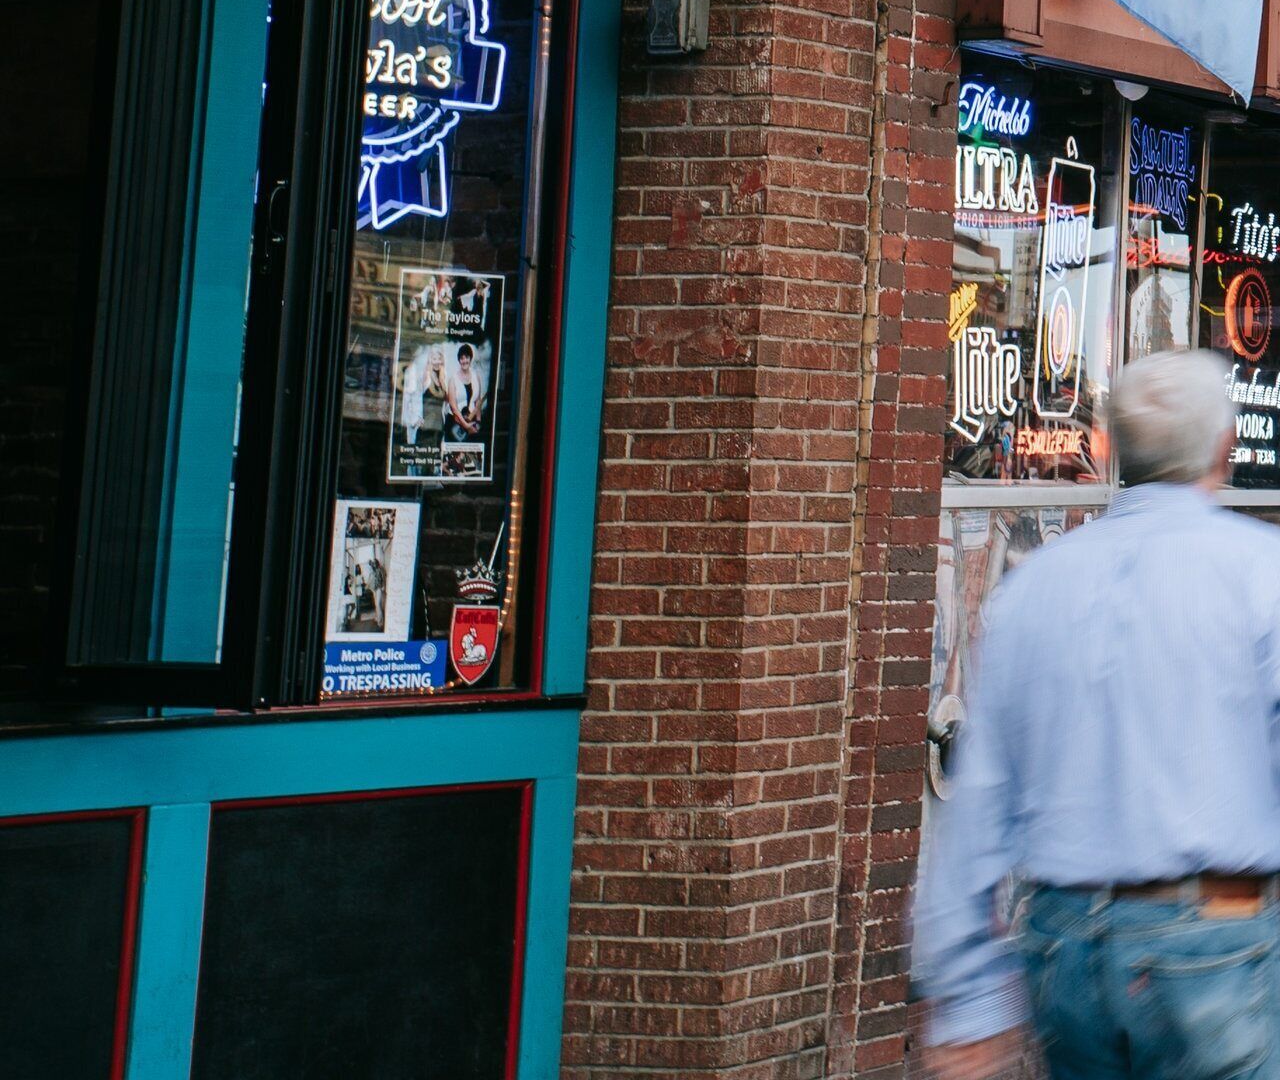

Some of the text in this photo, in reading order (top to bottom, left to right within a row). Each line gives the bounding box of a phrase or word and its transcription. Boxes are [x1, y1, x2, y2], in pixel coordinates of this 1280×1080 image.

[363, 93, 418, 119] EER
[958, 83, 1031, 135] Michelob
[1130, 117, 1195, 182] SAMUEL
[1135, 173, 1188, 232] ADAMS
[1231, 202, 1280, 262] Tito's
[422, 309, 480, 325] The Taylors
[950, 326, 1021, 443] Lite
[1235, 414, 1274, 440] VODKA
[341, 648, 405, 662] Metro Police
[325, 662, 421, 675] Working with Local Business
[338, 672, 432, 691] TRESPASSING
